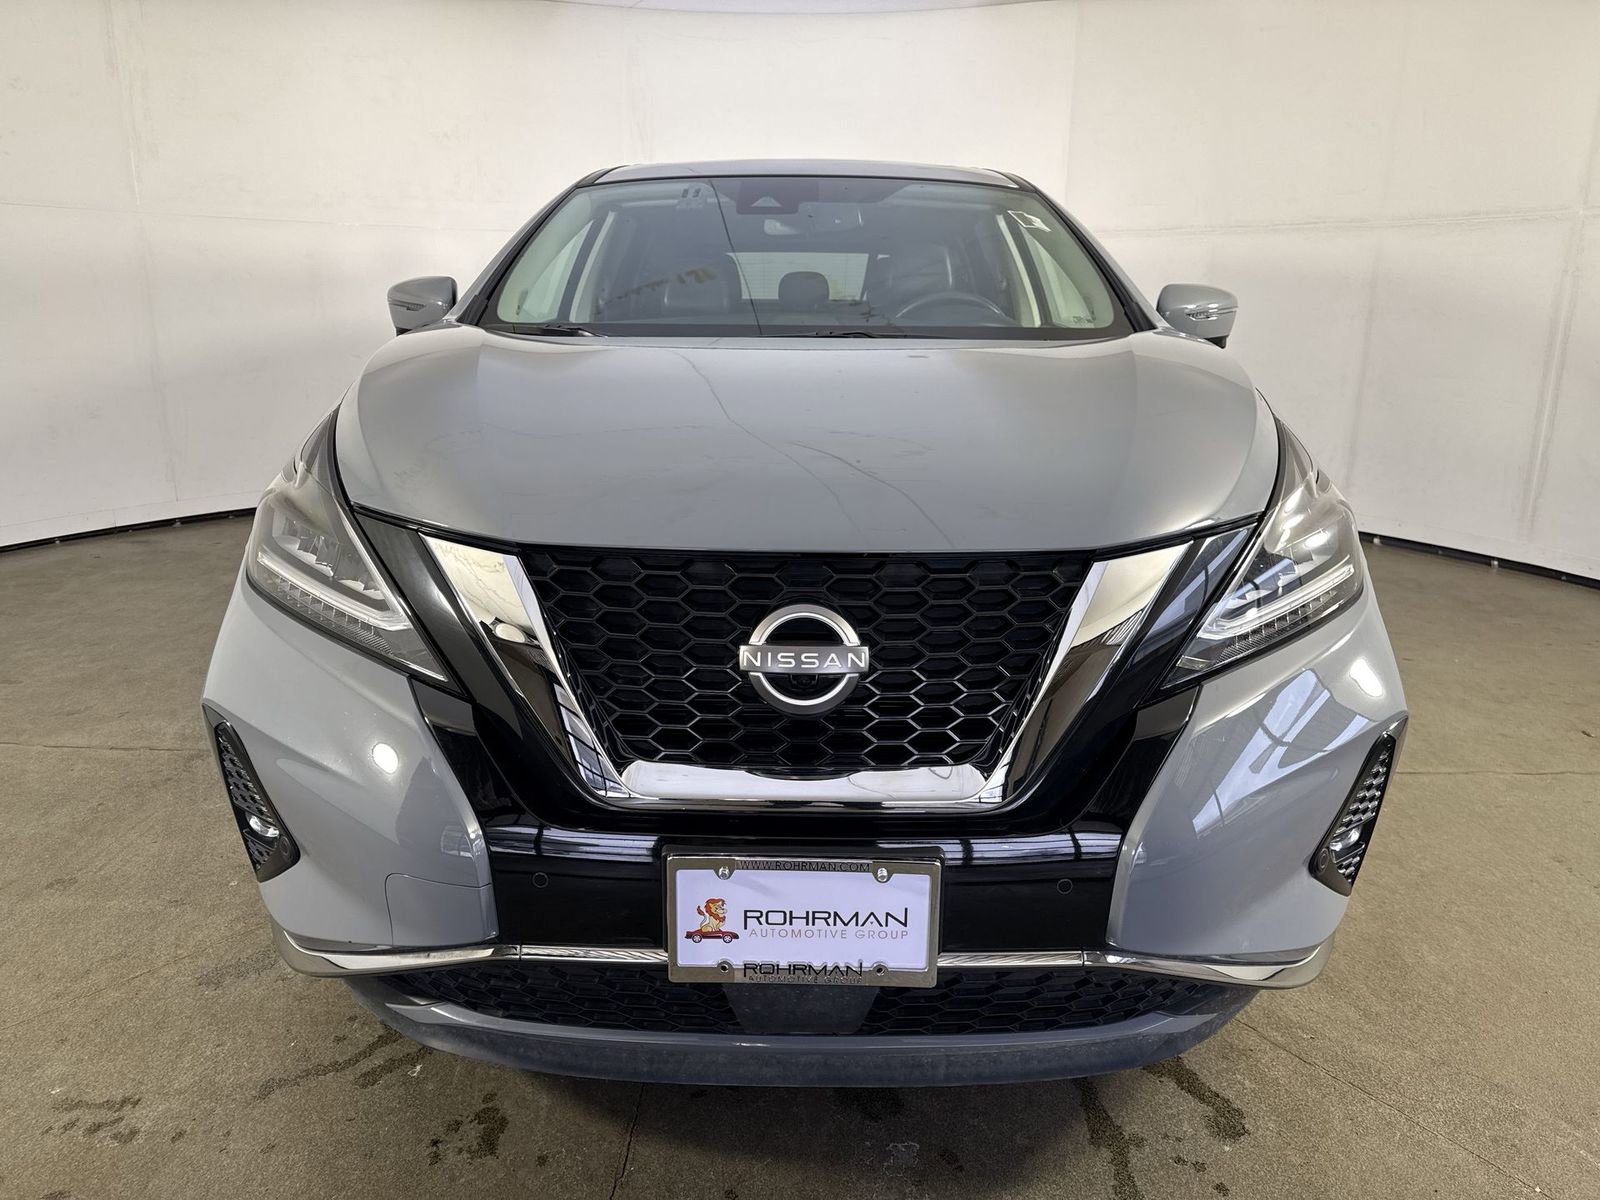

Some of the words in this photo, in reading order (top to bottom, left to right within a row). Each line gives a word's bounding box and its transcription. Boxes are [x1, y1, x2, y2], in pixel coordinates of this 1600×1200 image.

[743, 651, 865, 668] NISSAN
[740, 860, 870, 873] WWW.ROHRMAN.COM
[743, 907, 908, 930] ROHRMAN
[749, 928, 847, 939] AUTOMOTIVE
[855, 929, 908, 940] GROUP
[743, 961, 863, 978] ROHRMAN
